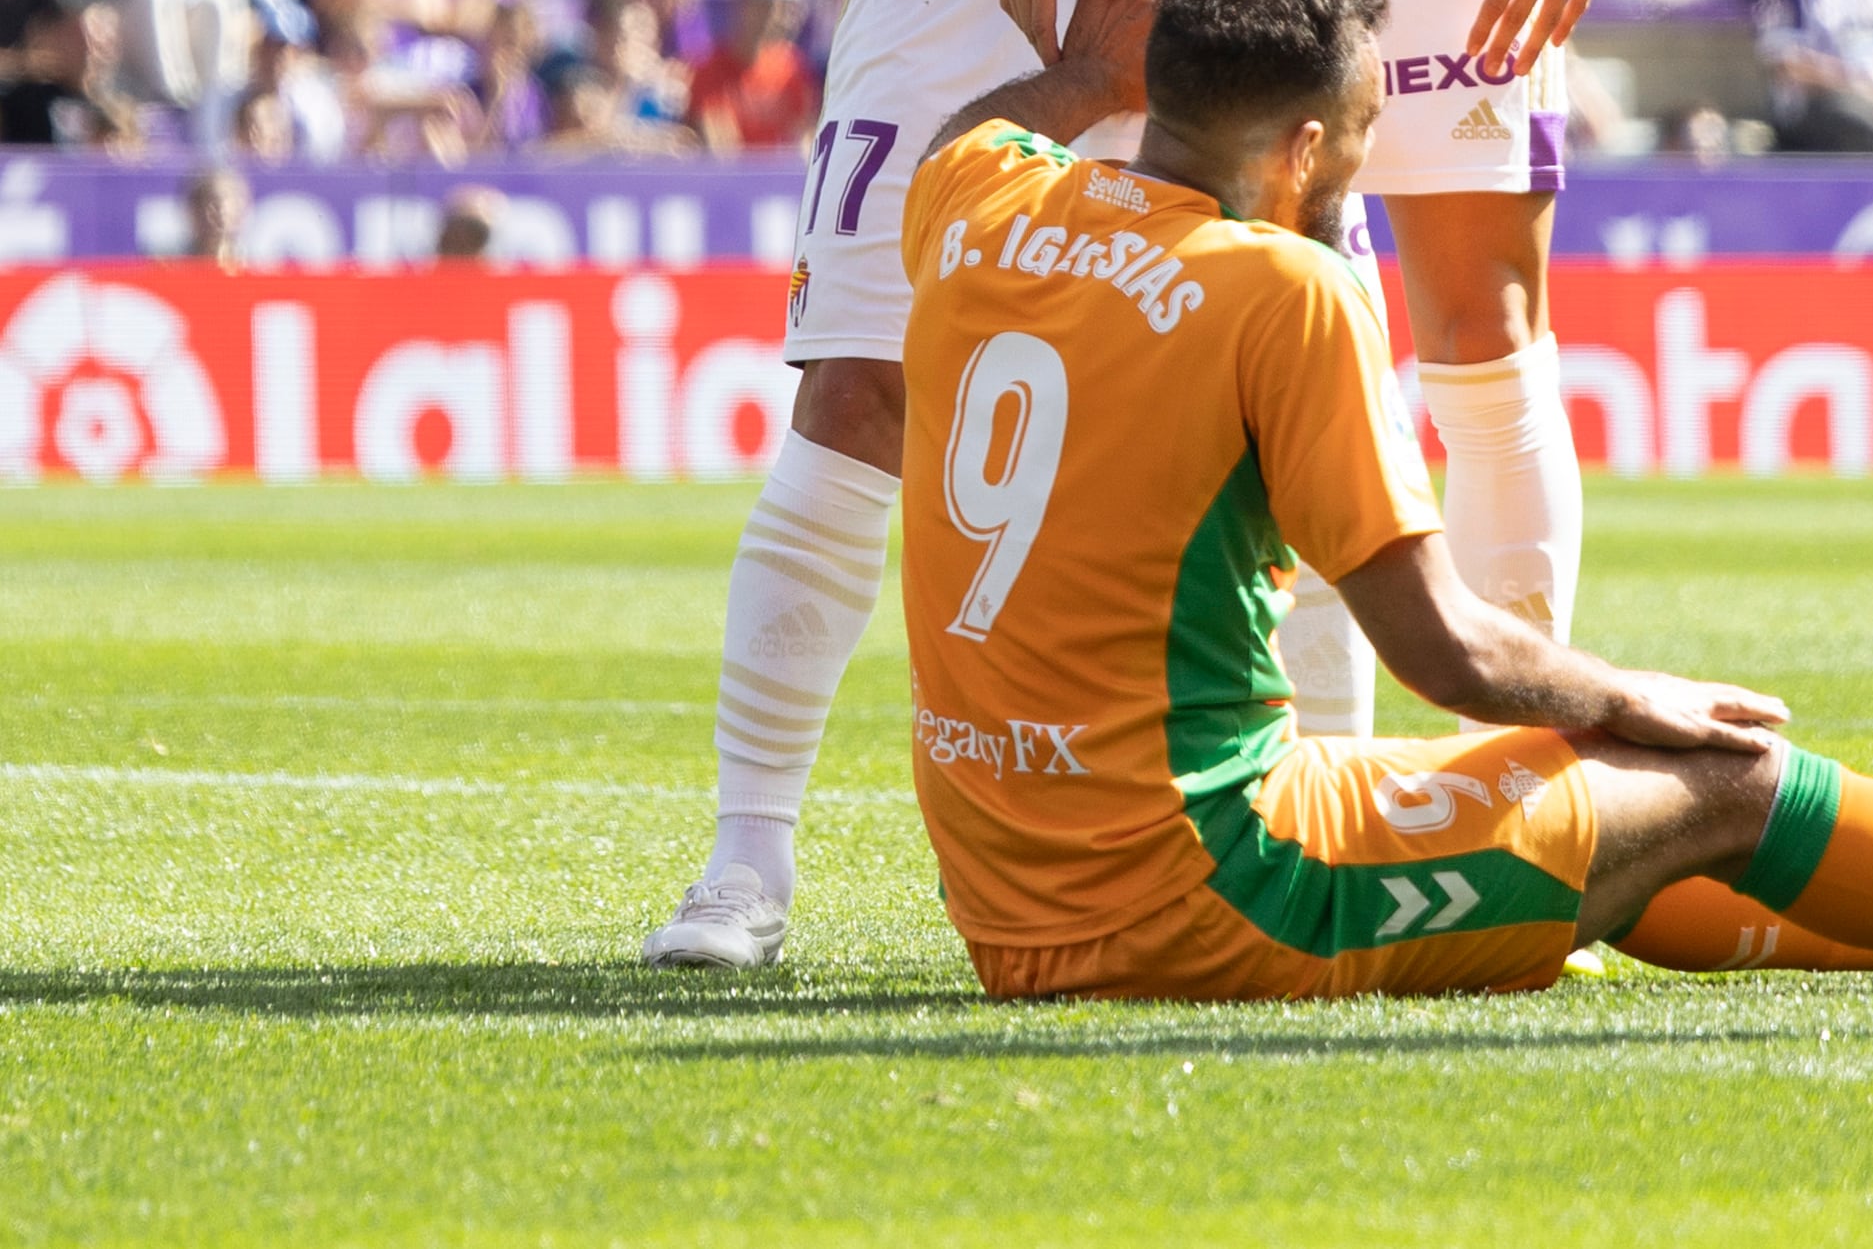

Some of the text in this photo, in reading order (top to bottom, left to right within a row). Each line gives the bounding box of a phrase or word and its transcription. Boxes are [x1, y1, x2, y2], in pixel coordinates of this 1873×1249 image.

[1451, 124, 1513, 141] adidas
[805, 118, 899, 237] 17
[938, 219, 983, 281] B.
[943, 330, 1069, 644] 9
[912, 704, 1092, 781] egacyFX
